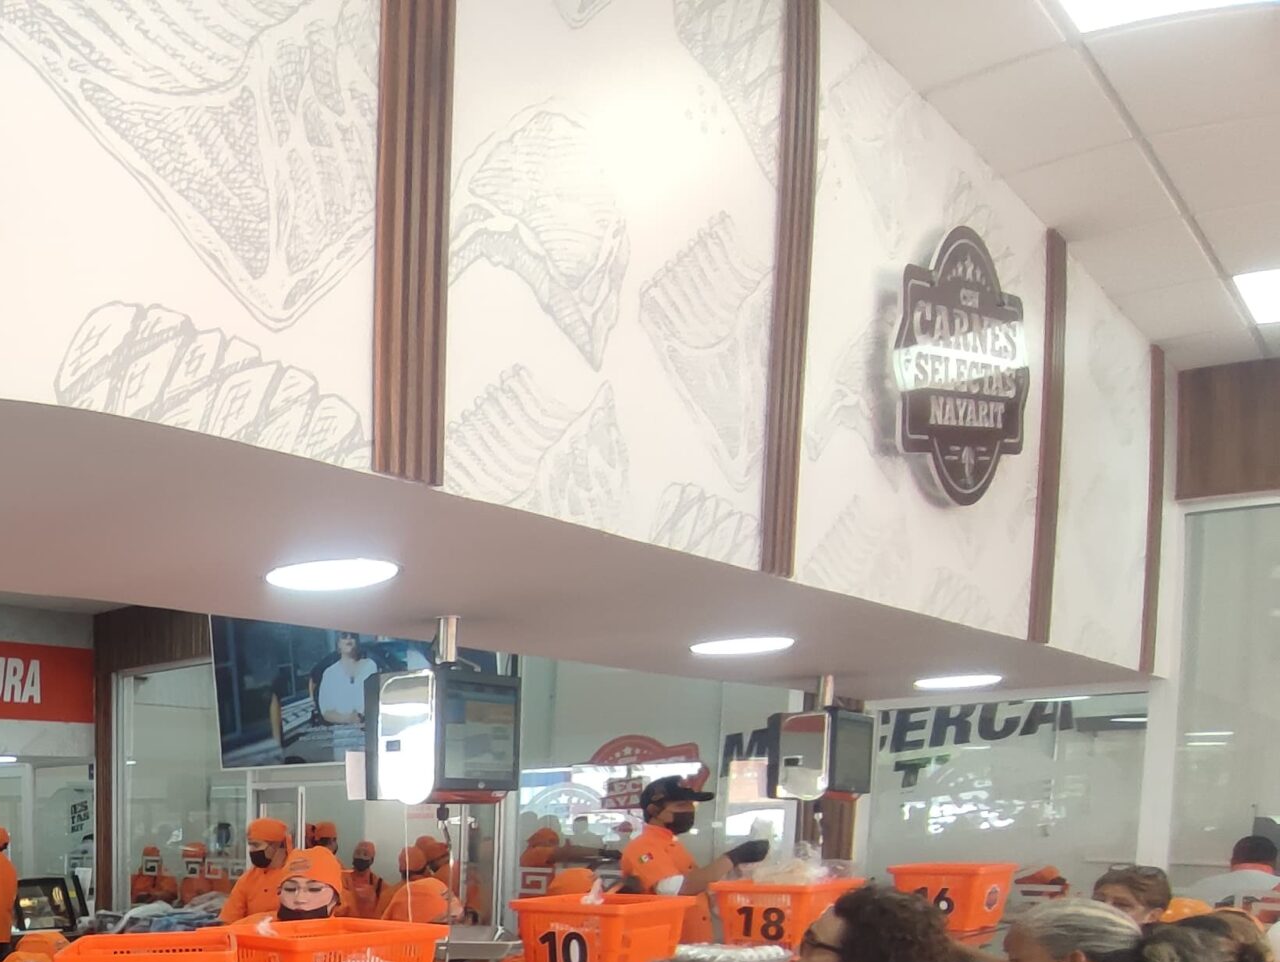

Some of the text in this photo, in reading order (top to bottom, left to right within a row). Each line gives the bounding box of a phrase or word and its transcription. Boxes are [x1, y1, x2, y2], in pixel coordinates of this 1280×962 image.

[913, 299, 1017, 361] CARNES
[914, 351, 1017, 398] SELECTAS
[929, 395, 1005, 428] NAYARIT
[878, 700, 1074, 753] ERCA
[736, 905, 785, 941] 18
